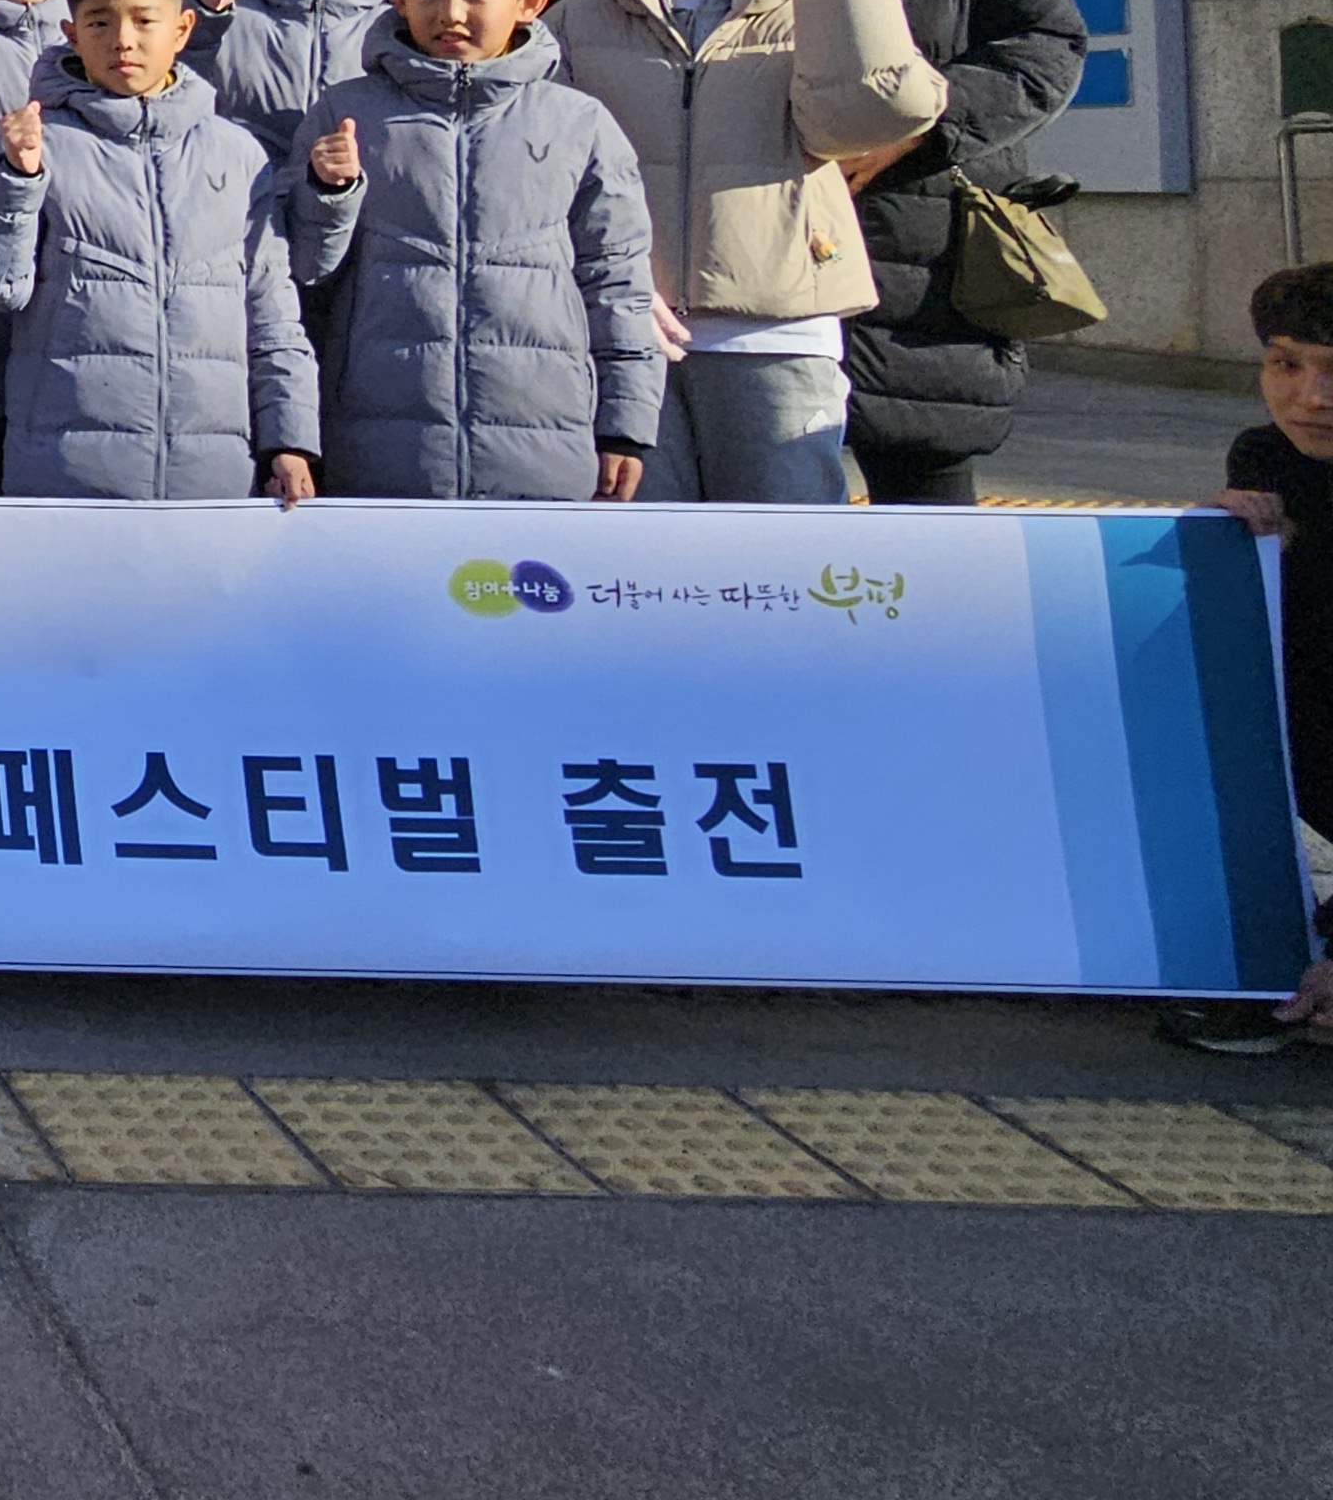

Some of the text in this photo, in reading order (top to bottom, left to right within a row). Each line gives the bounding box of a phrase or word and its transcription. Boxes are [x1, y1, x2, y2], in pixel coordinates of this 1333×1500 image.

[585, 563, 906, 625] 더불어 사는 따뜻한 부평
[561, 758, 805, 879] 출전
